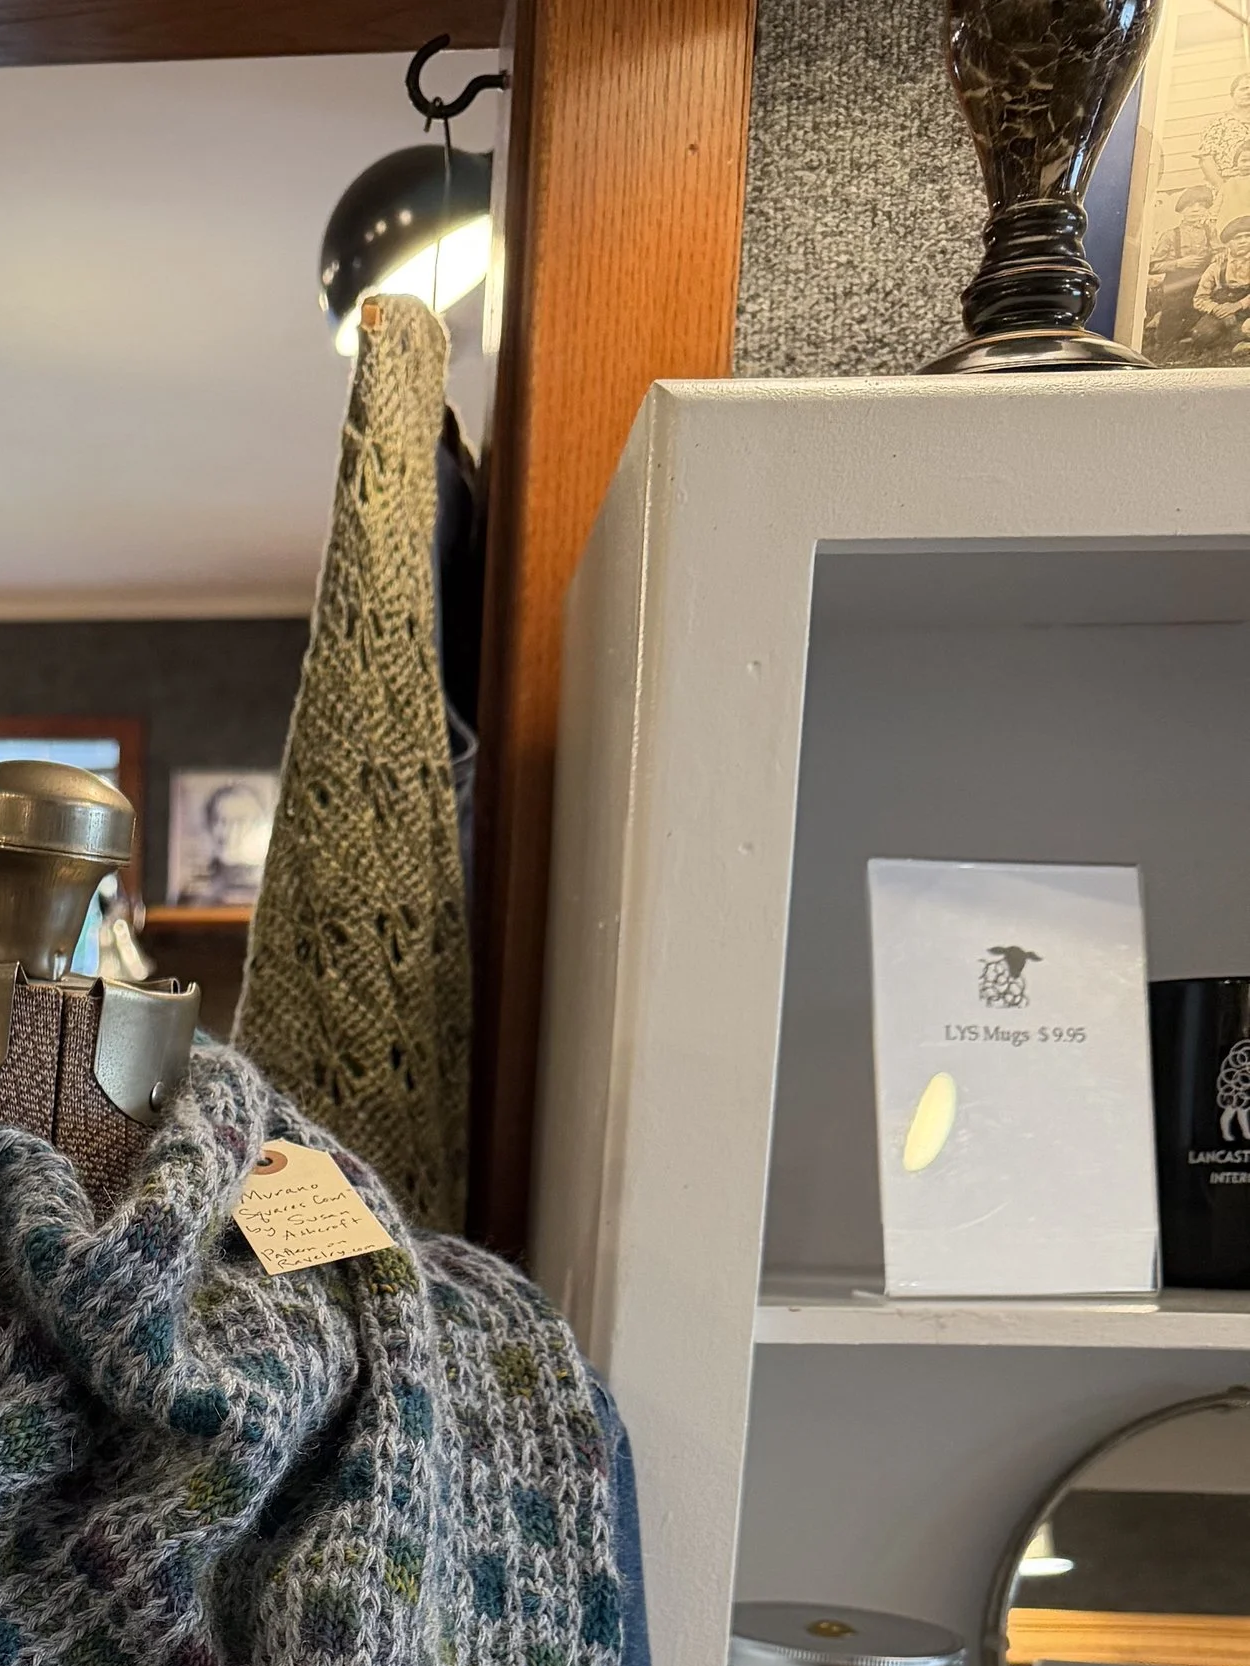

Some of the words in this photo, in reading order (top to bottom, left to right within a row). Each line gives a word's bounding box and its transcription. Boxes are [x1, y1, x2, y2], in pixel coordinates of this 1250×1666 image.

[944, 1024, 980, 1041] LYS
[983, 1025, 1030, 1047] Mugs
[241, 1183, 318, 1204] Murano
